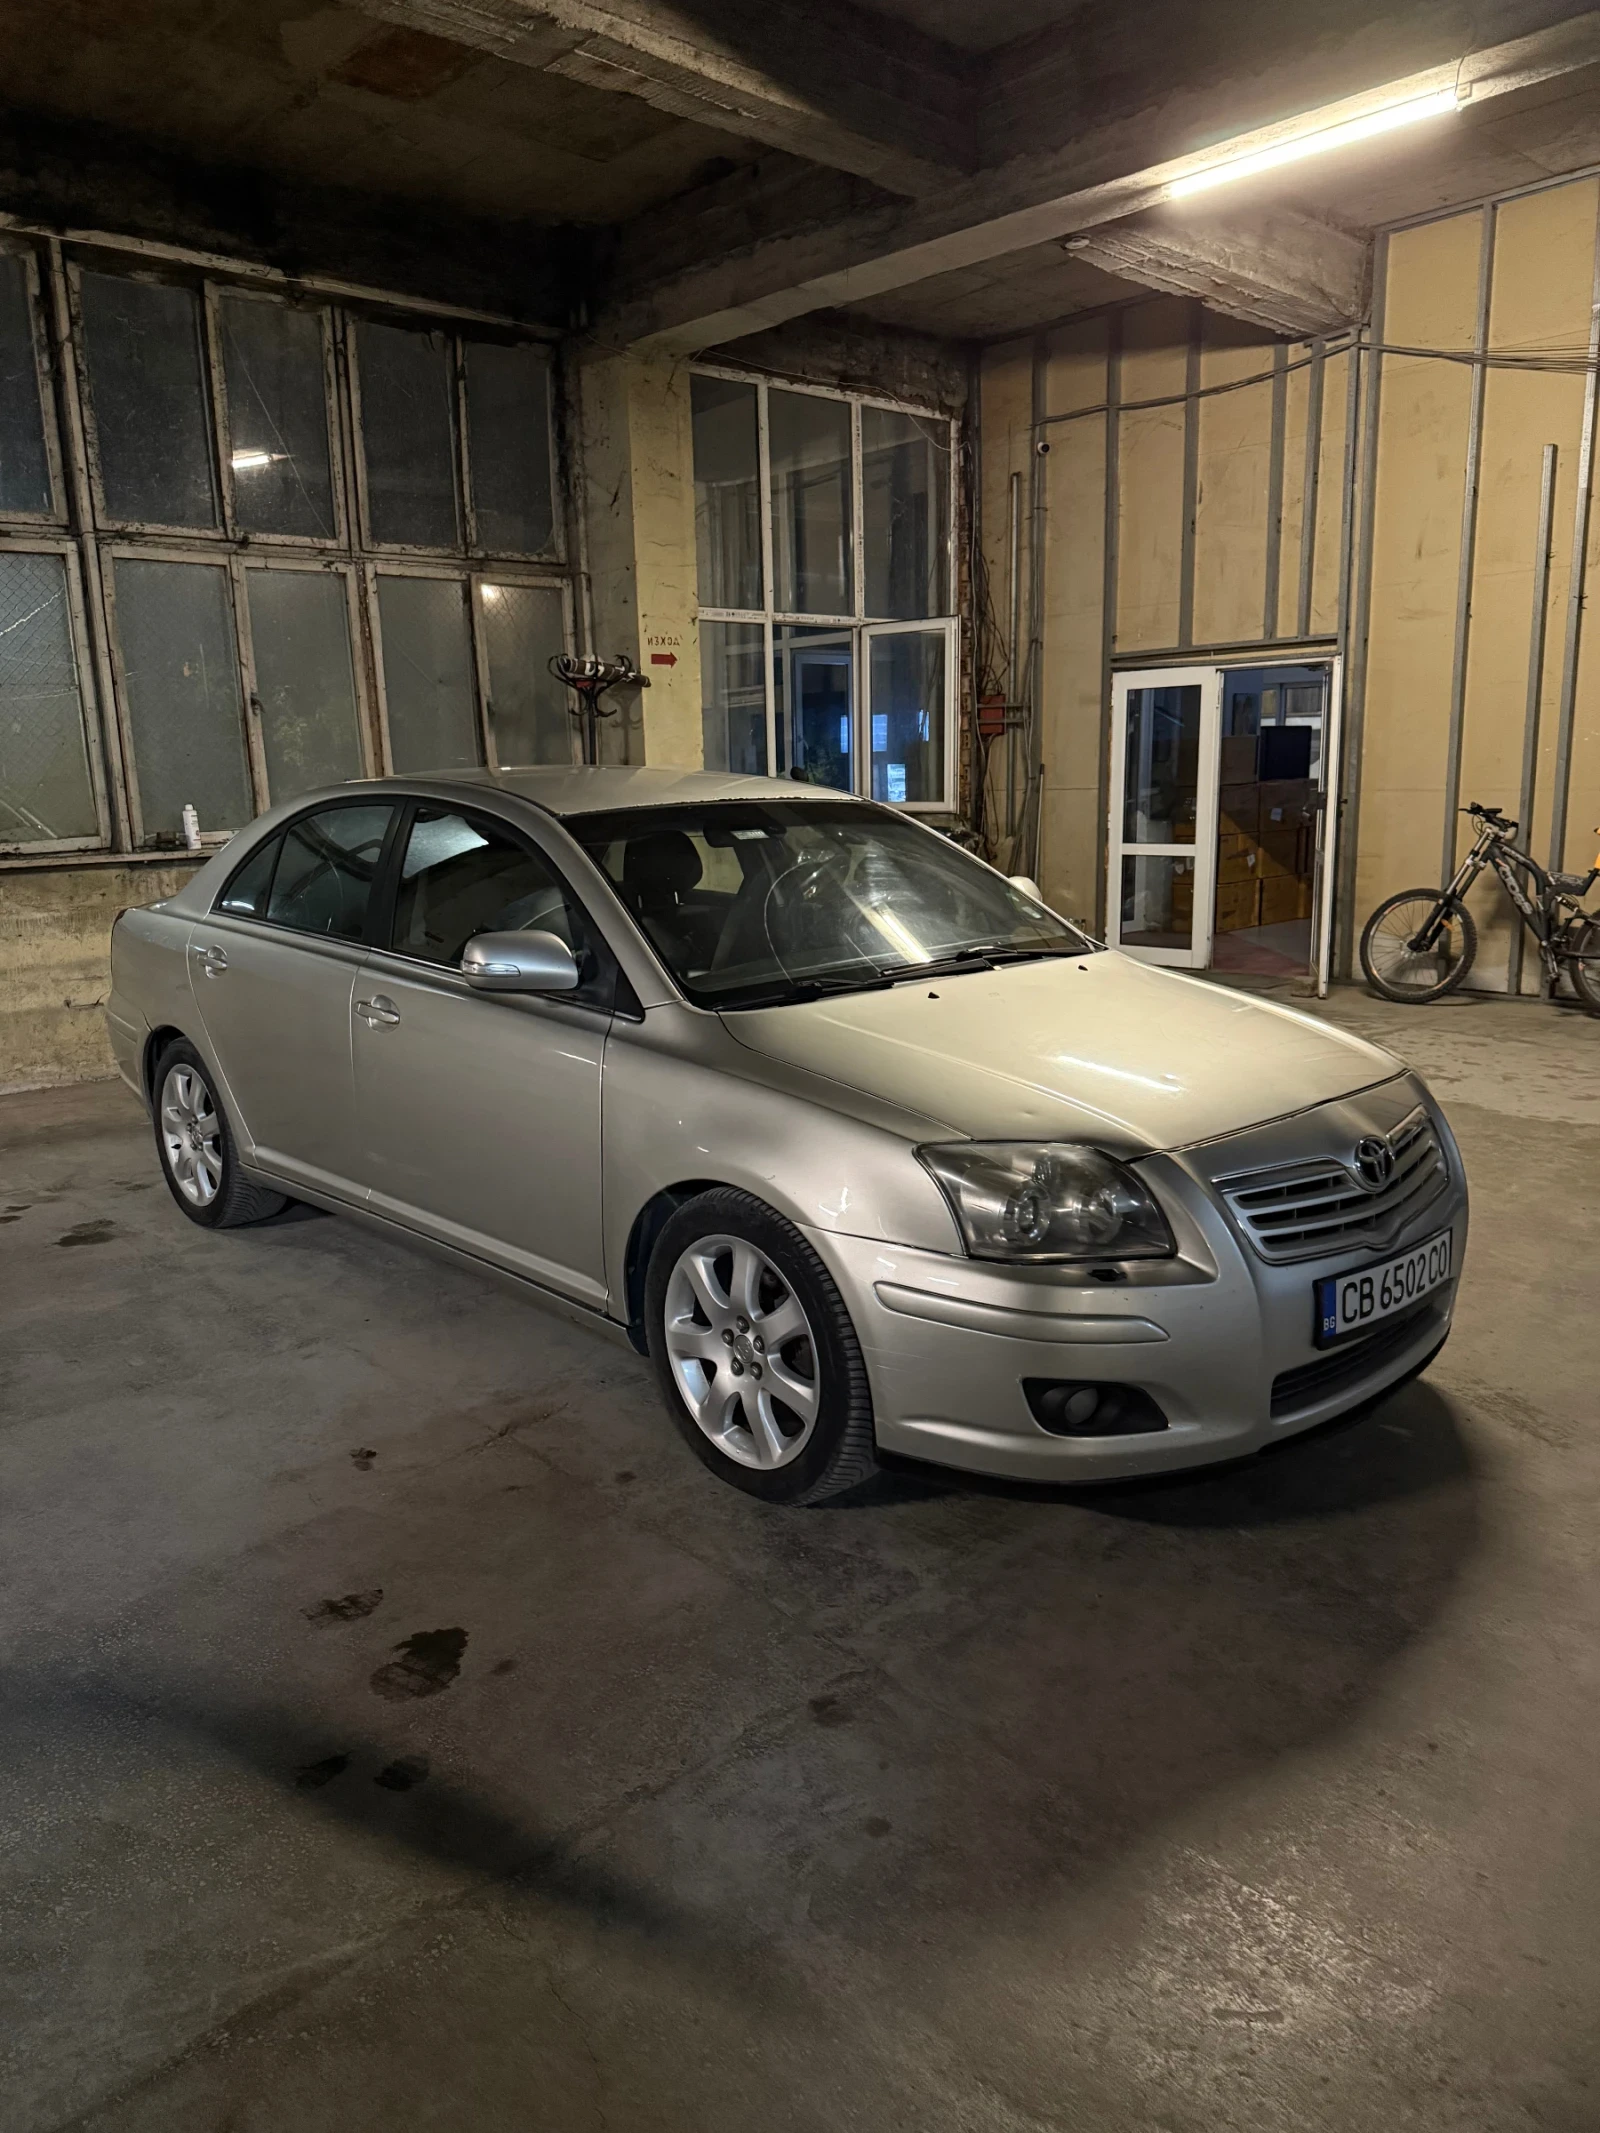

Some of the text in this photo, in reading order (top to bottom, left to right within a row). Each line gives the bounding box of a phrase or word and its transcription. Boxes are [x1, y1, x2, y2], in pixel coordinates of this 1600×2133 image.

[647, 636, 680, 646] ИЗХОД
[1342, 1240, 1448, 1323] CB 6502 CO
[1323, 1315, 1336, 1331] BG
